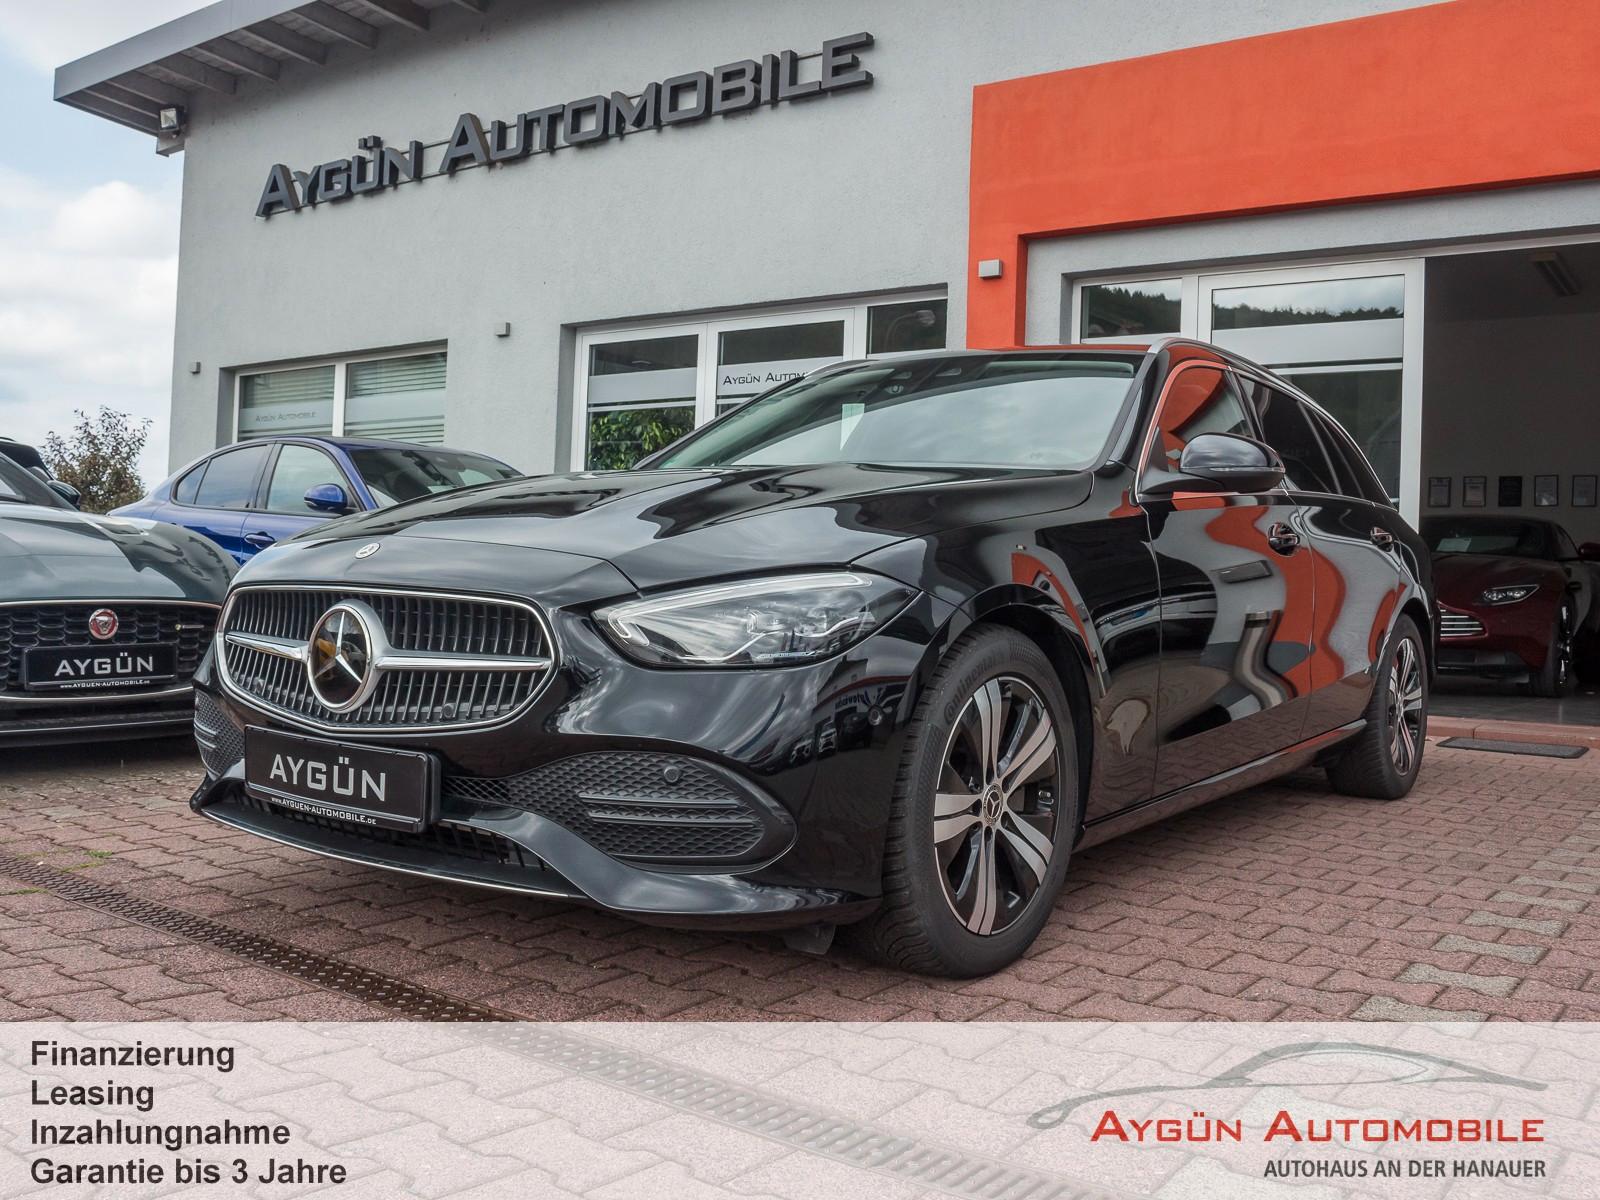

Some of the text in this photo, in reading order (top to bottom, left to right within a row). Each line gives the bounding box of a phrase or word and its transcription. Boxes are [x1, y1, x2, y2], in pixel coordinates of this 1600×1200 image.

[255, 31, 875, 217] AYGÜN AUTOMOBILE
[722, 371, 808, 385] AYGÜN AUTOM
[54, 652, 154, 677] AYGÜN
[269, 753, 386, 802] AYGÜN
